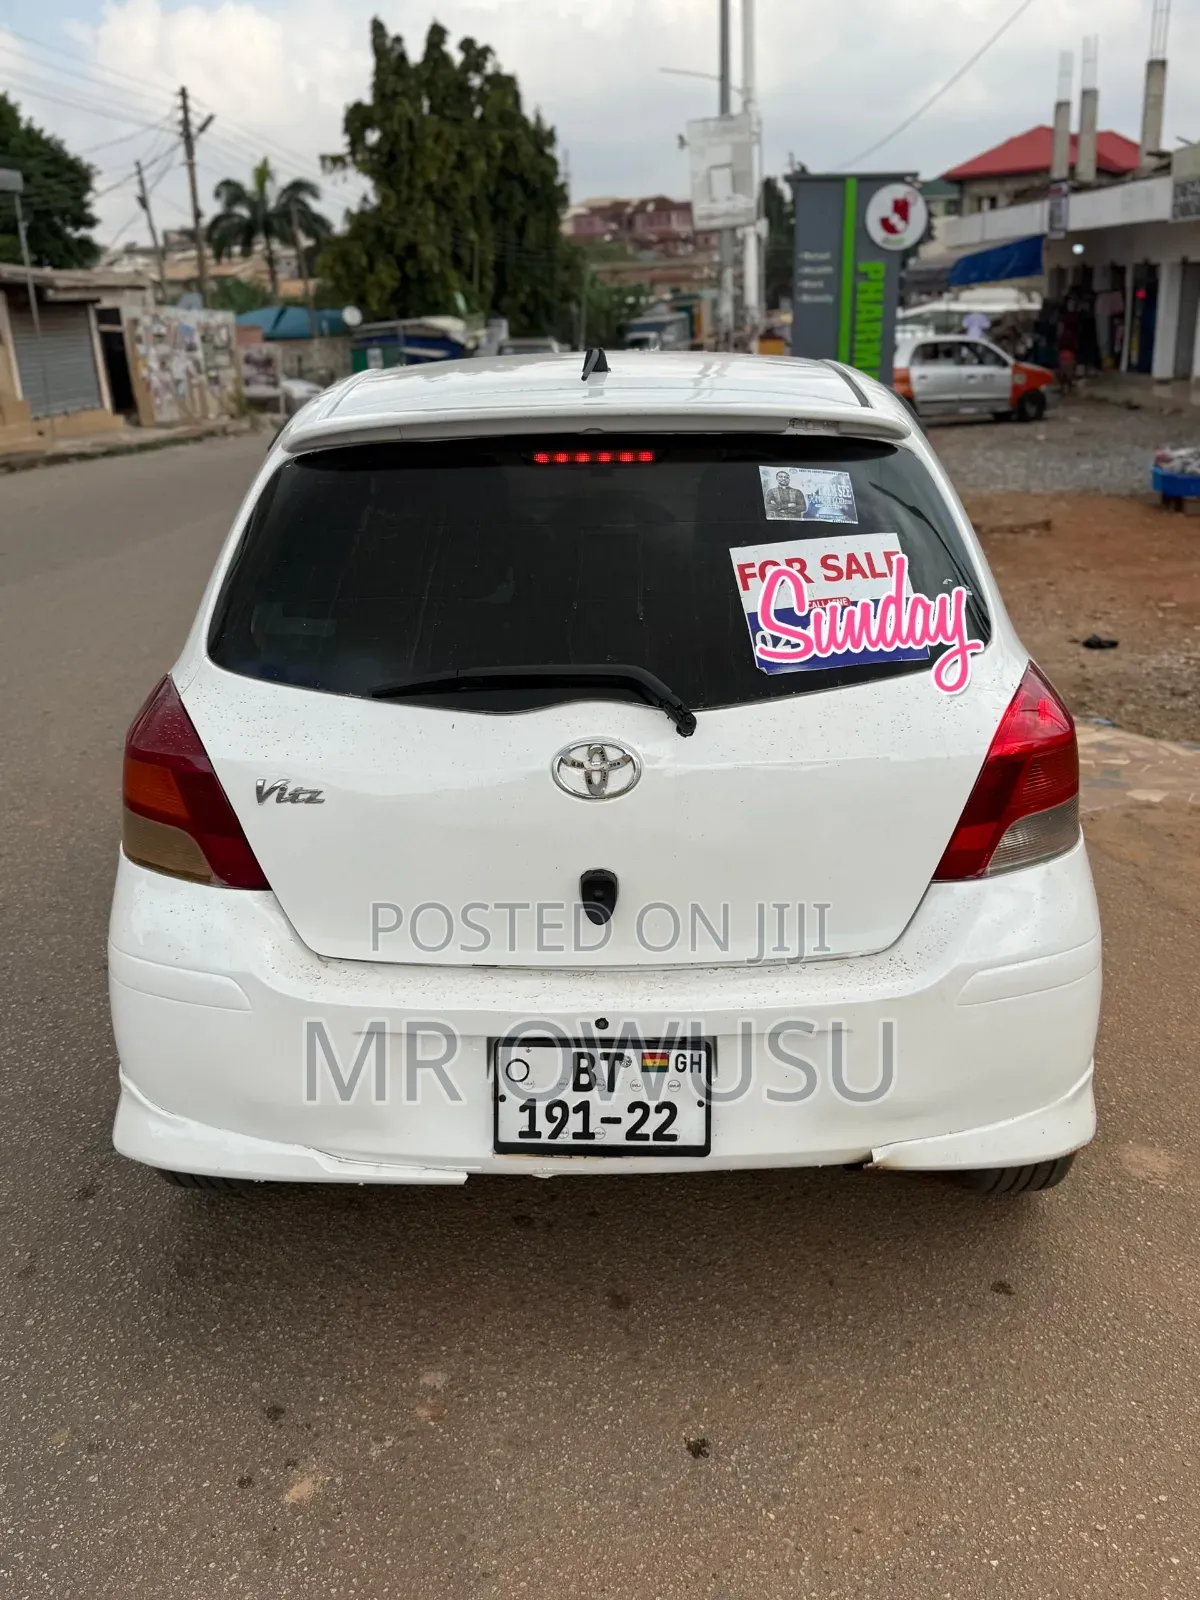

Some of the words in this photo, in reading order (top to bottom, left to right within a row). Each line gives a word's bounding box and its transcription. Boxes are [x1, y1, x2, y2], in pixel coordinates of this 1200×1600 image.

[854, 262, 885, 381] PHARM
[256, 778, 326, 806] Vitz
[572, 1051, 625, 1093] BT
[675, 1053, 703, 1074] GH
[518, 1097, 679, 1142] 191-22
